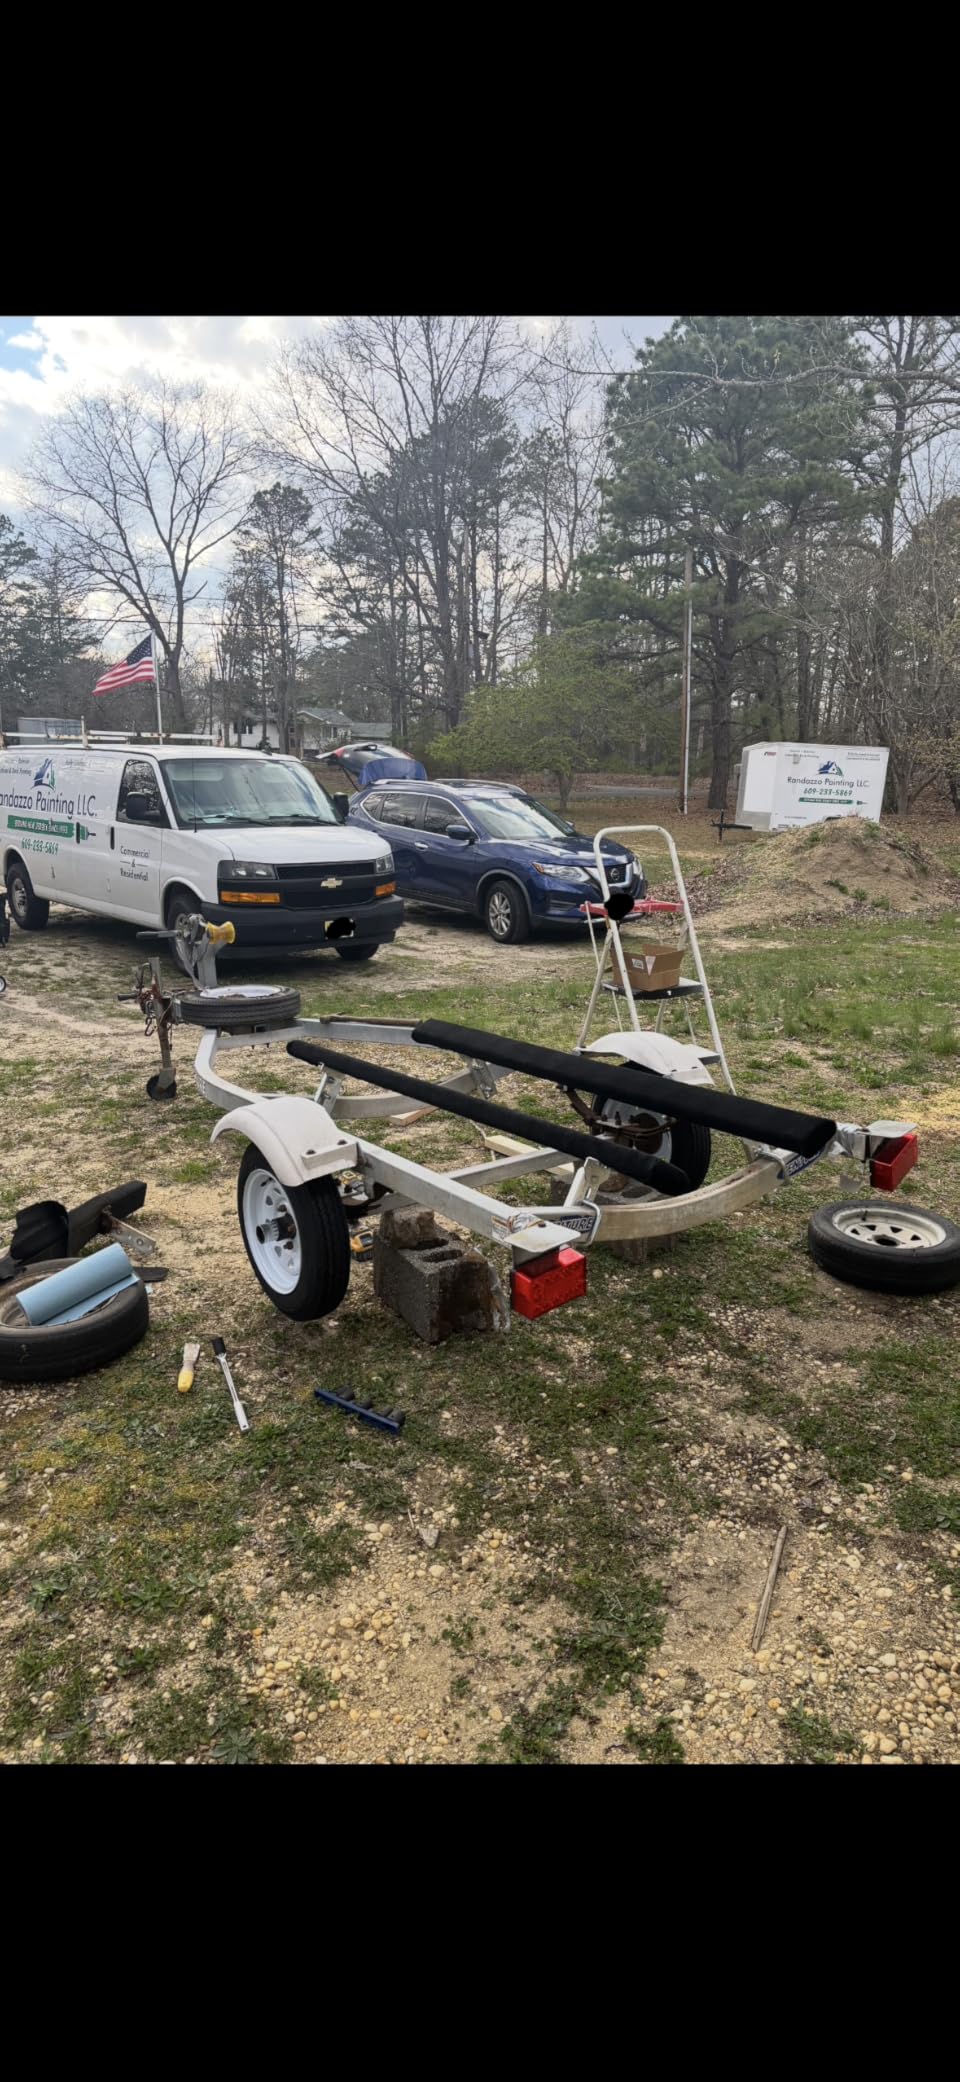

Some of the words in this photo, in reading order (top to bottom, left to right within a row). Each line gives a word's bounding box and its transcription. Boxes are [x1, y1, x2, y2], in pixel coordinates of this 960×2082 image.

[787, 776, 823, 785] Randazzo
[825, 778, 854, 788] Painting
[0, 787, 33, 810] andazzo
[36, 791, 74, 820] Painting
[77, 794, 97, 817] LLC.
